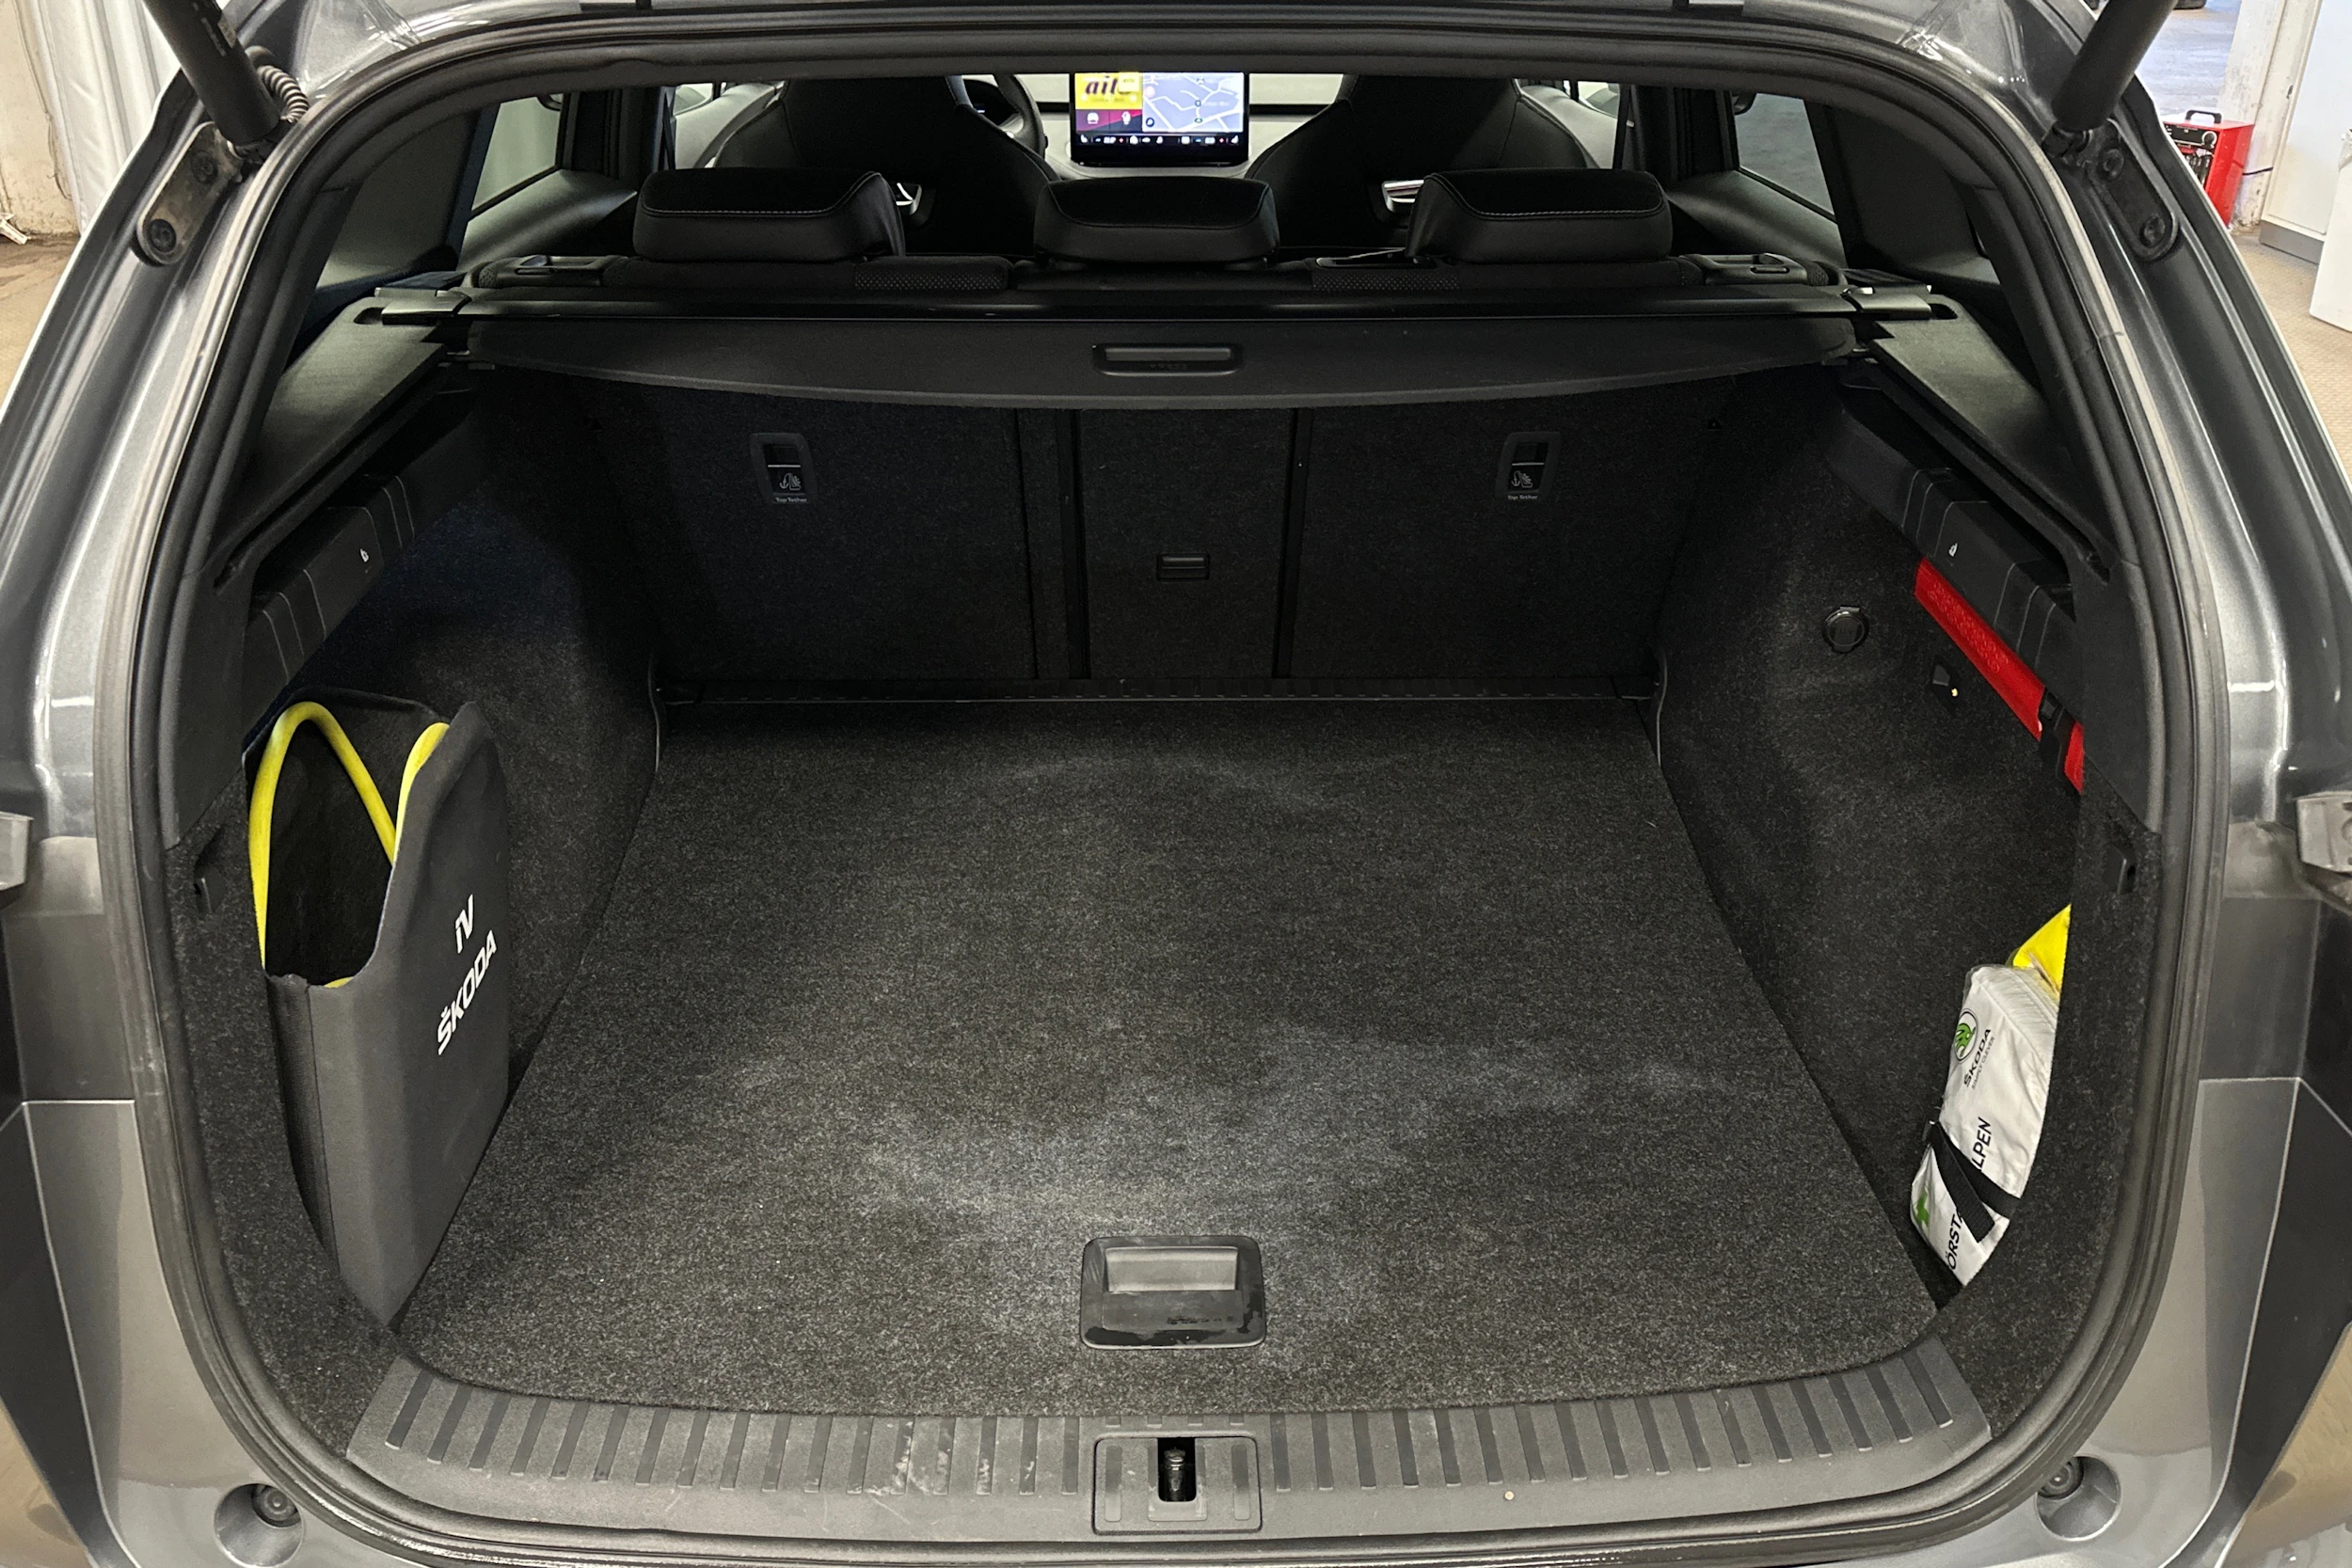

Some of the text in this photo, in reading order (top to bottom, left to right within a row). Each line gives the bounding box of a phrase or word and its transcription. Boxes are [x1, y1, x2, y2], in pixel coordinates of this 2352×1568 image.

[437, 929, 498, 1056] ŠKODA
[1981, 1036, 1995, 1064] CLEVER
[1945, 1116, 1992, 1270] ÖRST LPEN
